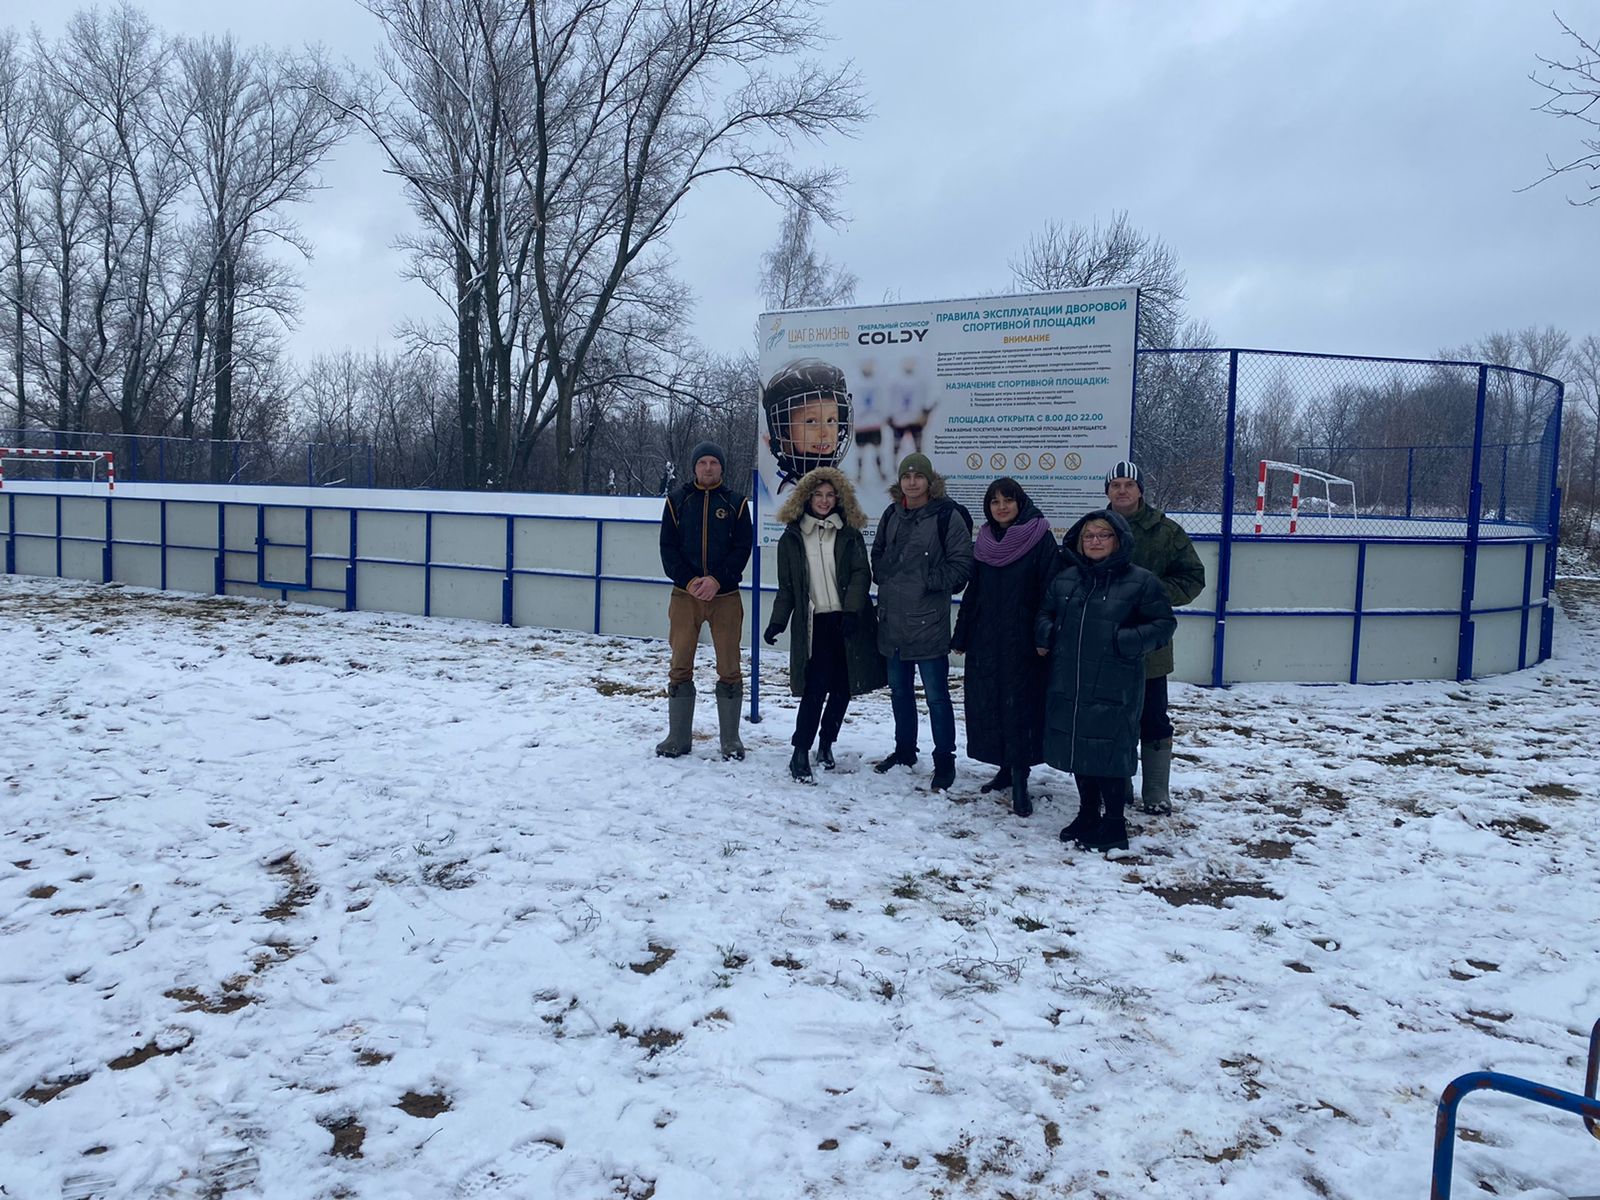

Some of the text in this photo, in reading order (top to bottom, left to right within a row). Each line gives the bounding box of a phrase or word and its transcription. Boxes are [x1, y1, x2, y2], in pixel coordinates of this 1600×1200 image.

[936, 300, 1127, 322] ПРАВИЛА ЭКСПЛУАТАЦИИ ДВОРОВОЙ
[857, 320, 930, 331] ГЕНЕРАЛЬНЫЙ СПОНСОР
[962, 315, 1096, 332] СПОРТИВНОЙ ПЛОЩАДКИ
[788, 326, 849, 343] ШАГ В ЖИЗНЬ
[857, 329, 929, 345] COLDY
[1003, 334, 1050, 344] ВНИМАНИЕ
[946, 376, 1109, 390] НАЗНАЧЕНИЕ СПОРТИВНОЙ ПЛОЩАДКИ:
[948, 413, 1103, 425] ПЛОЩАДКА ОТКРЫТА С 8.00 ДО 22.00
